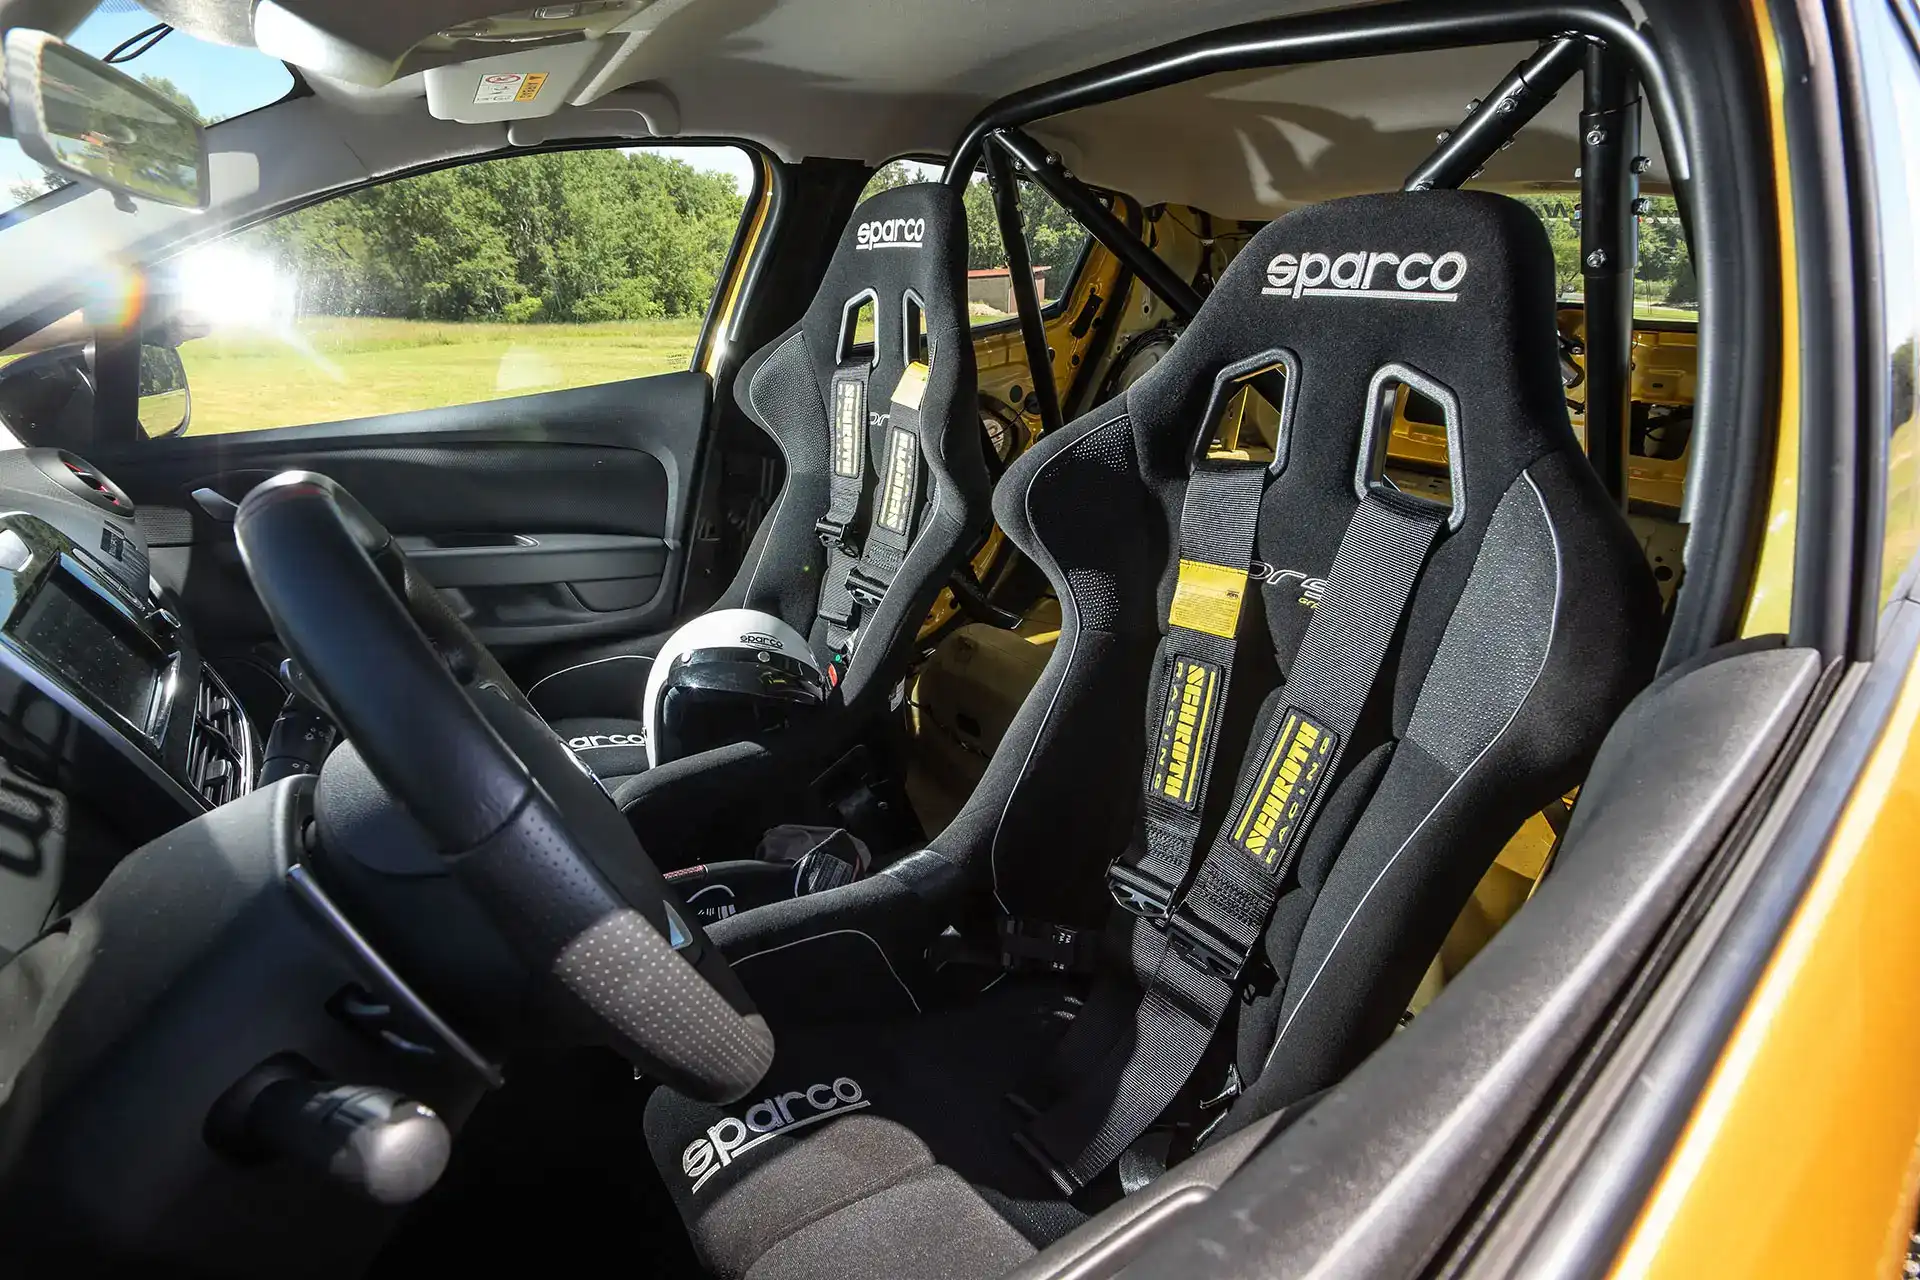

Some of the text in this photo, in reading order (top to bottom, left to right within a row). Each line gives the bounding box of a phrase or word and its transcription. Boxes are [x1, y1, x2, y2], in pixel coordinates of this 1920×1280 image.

[857, 218, 925, 250] sparco
[1266, 251, 1467, 298] sparco
[740, 635, 783, 649] sparco
[568, 734, 646, 749] arco
[1154, 662, 1184, 790] RACING
[1164, 664, 1205, 798] SCHROTH
[1245, 721, 1320, 855] SCHROTH
[1266, 737, 1330, 864] RACING
[682, 1077, 863, 1177] sparco
